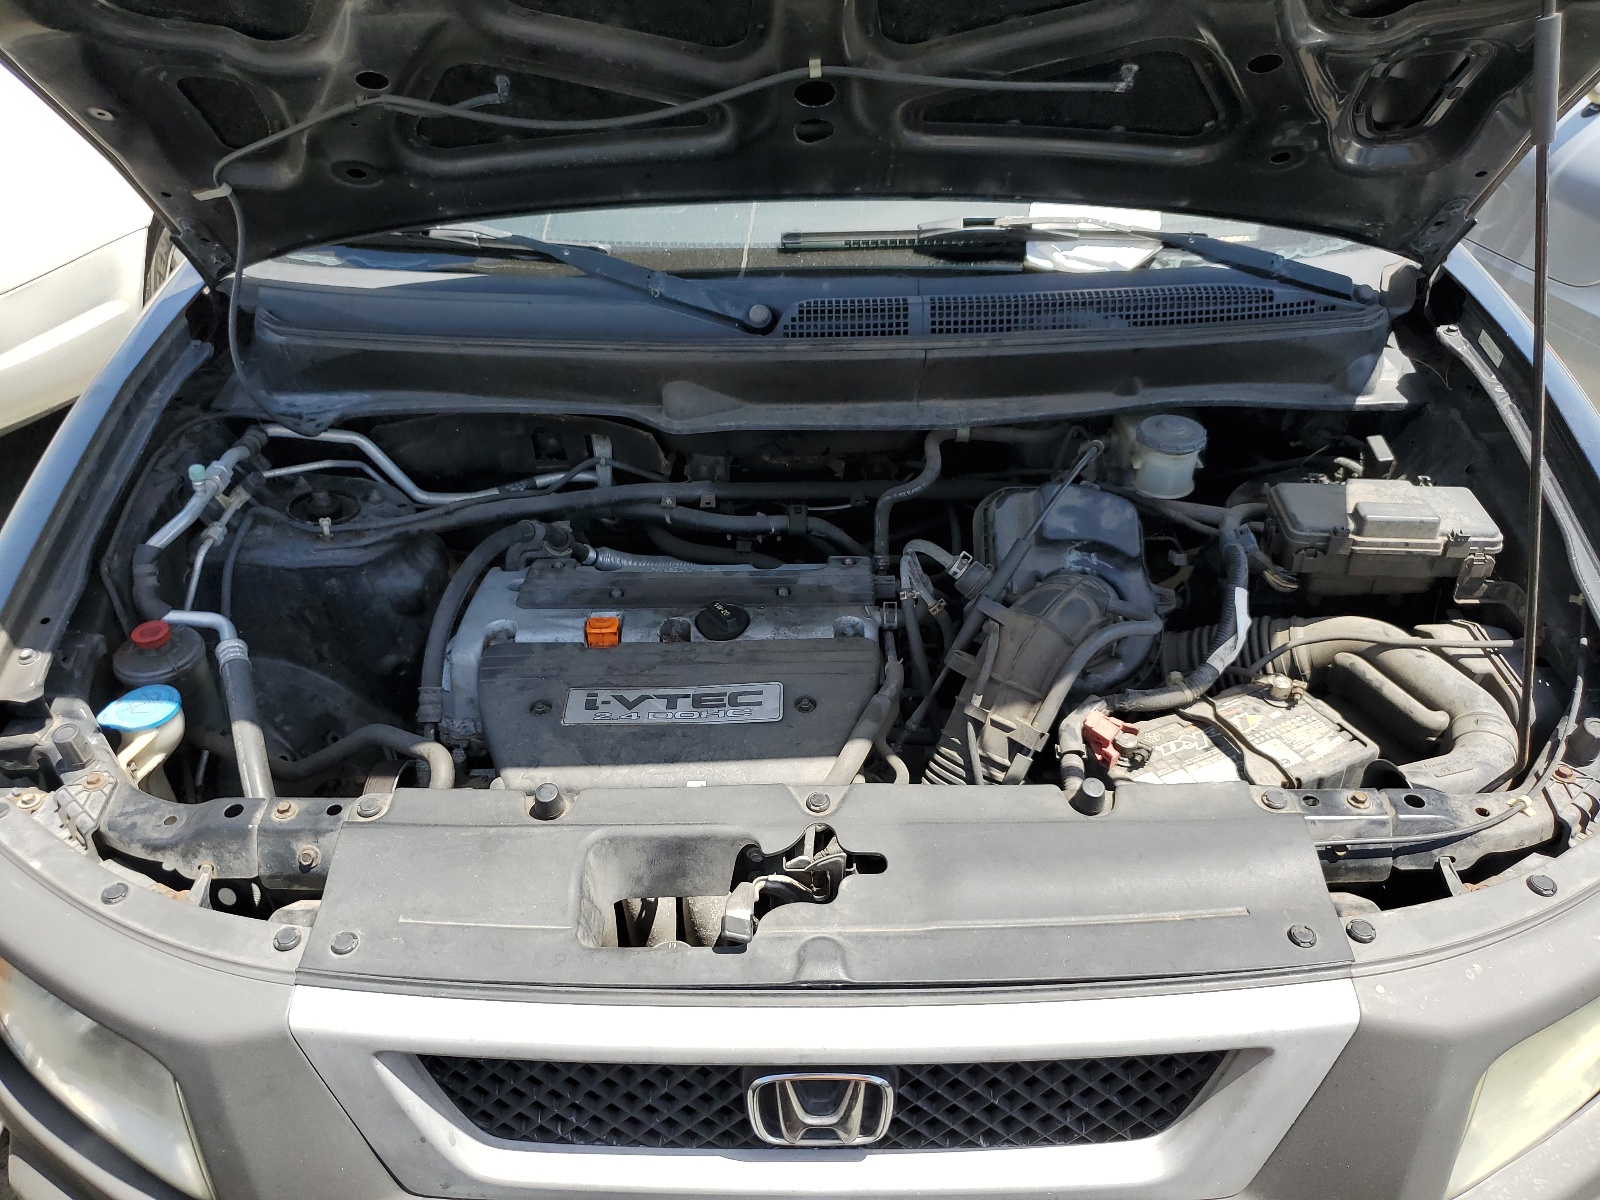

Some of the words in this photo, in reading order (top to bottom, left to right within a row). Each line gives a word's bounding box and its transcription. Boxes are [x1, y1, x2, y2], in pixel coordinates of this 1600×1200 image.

[584, 690, 763, 711] i-VTEC
[592, 711, 641, 721] 2.4
[647, 708, 753, 720] DOHC
